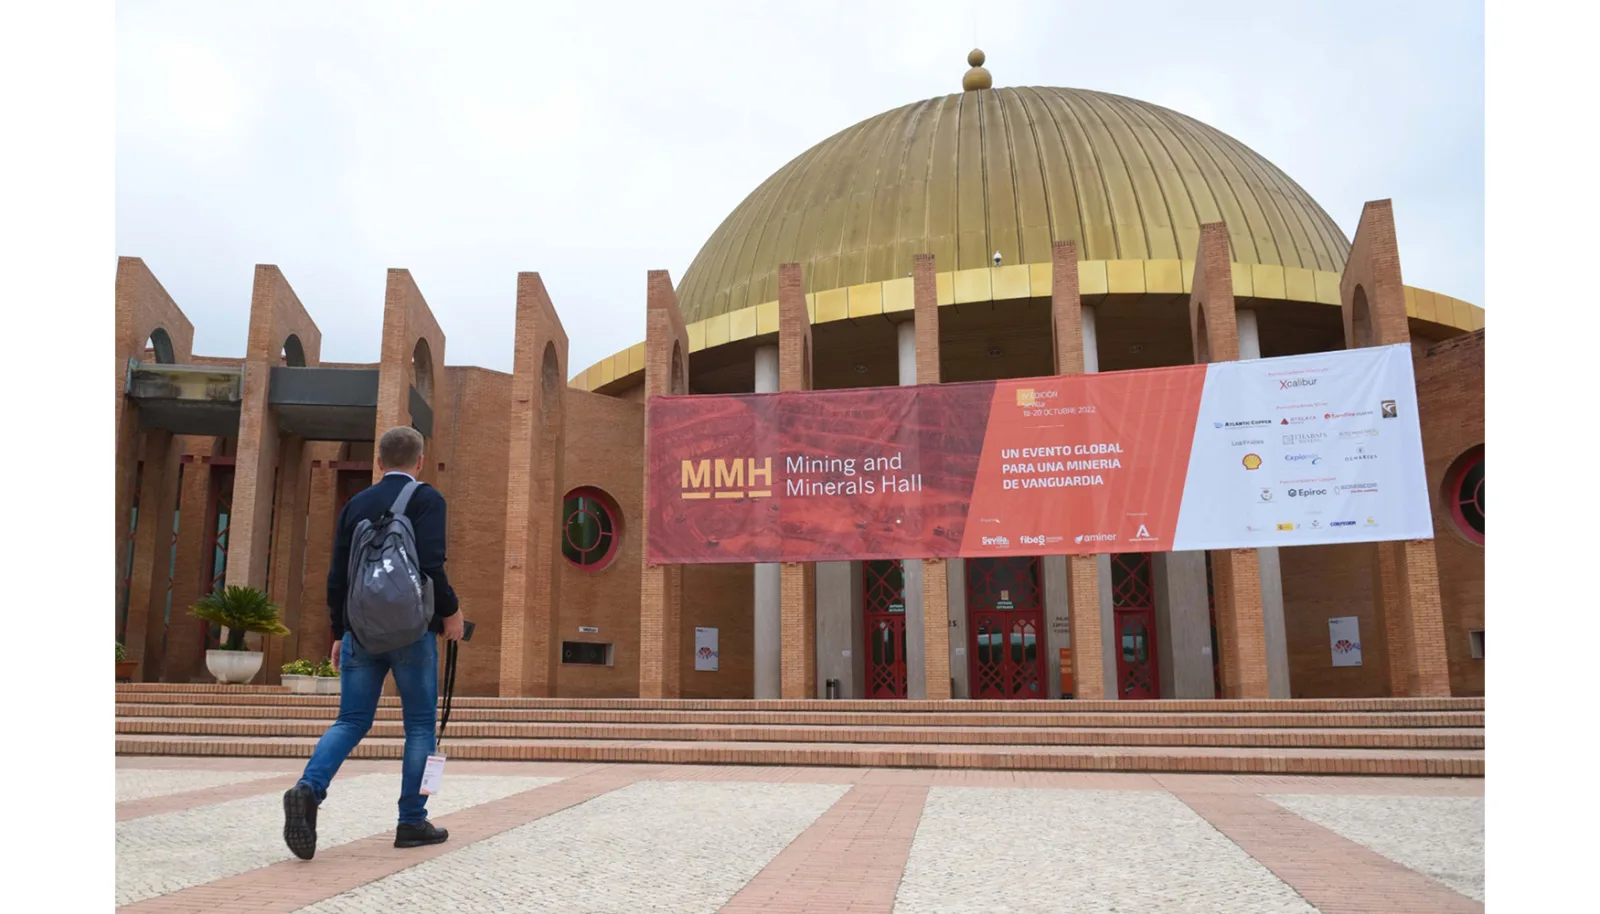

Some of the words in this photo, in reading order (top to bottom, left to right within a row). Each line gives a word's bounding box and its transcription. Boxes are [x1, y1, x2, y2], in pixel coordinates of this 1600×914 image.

[1280, 378, 1317, 390] Xcalibur
[1043, 407, 1076, 416] OCTUBRE
[1078, 406, 1096, 414] 2022
[1001, 448, 1019, 459] UN
[1022, 445, 1072, 458] EVENTO
[1074, 442, 1123, 455] GLOBAL
[681, 457, 772, 488] MMH
[786, 454, 857, 477] Mining
[864, 451, 902, 471] and
[1002, 462, 1035, 474] PARA
[1037, 461, 1064, 472] UNA
[1066, 458, 1121, 471] MINERIA
[786, 477, 875, 496] Minerals
[882, 474, 922, 493] Hall
[1003, 478, 1019, 490] DE
[1021, 475, 1104, 489] VANGUARDIA
[1298, 488, 1327, 497] Epiroc
[1084, 532, 1117, 542] aminer
